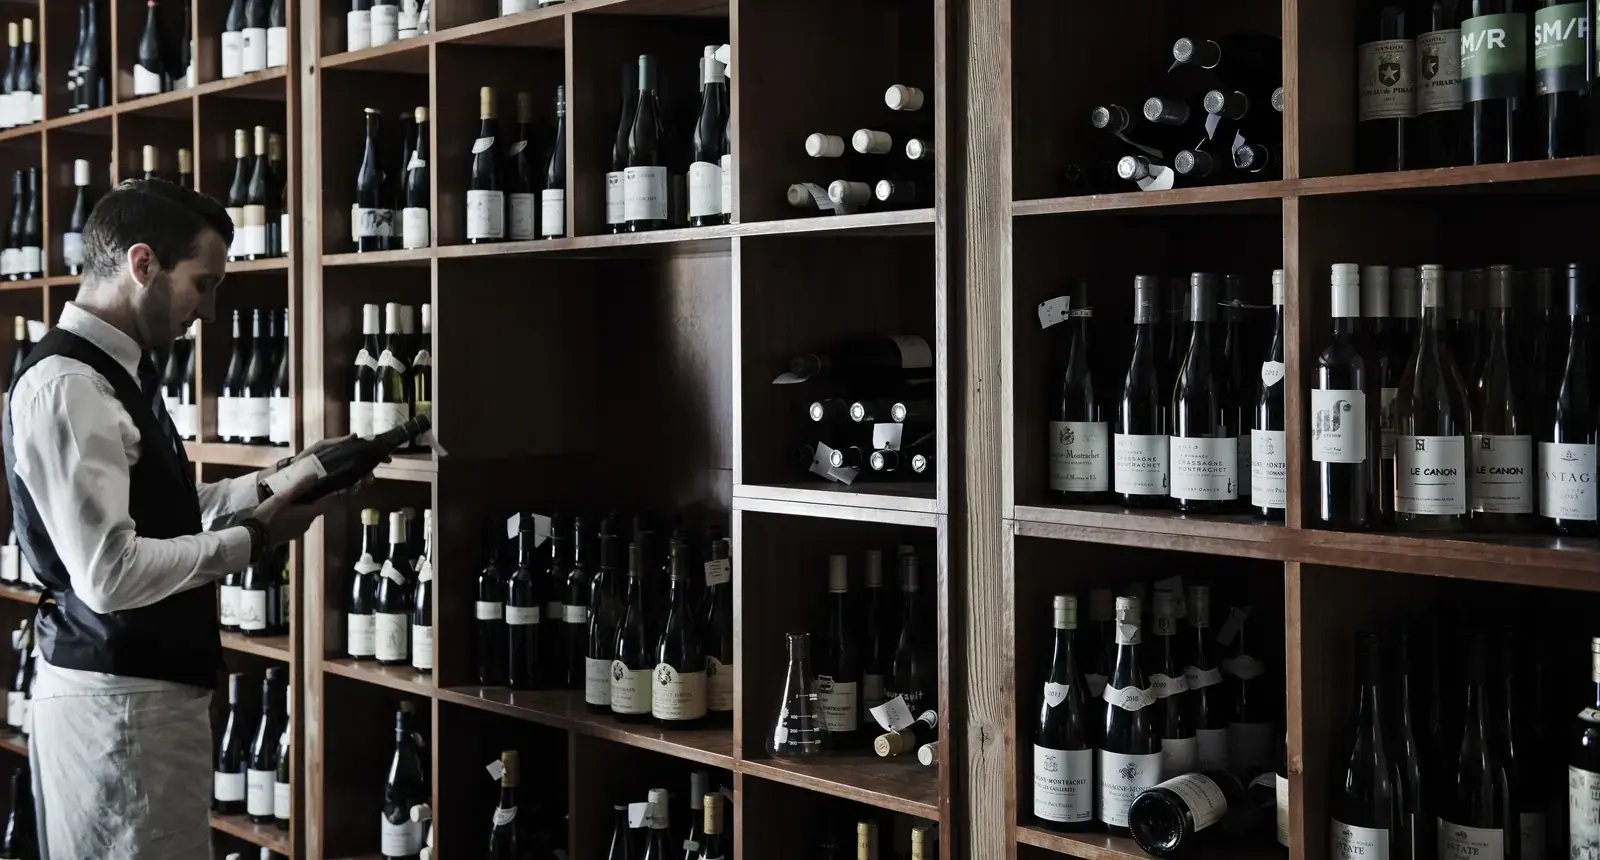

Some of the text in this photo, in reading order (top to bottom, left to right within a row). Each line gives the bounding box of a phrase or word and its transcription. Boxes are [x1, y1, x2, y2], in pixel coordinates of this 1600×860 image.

[1461, 28, 1506, 55] M/R
[1410, 467, 1457, 476] LE CANON
[1476, 466, 1523, 475] LE CANON
